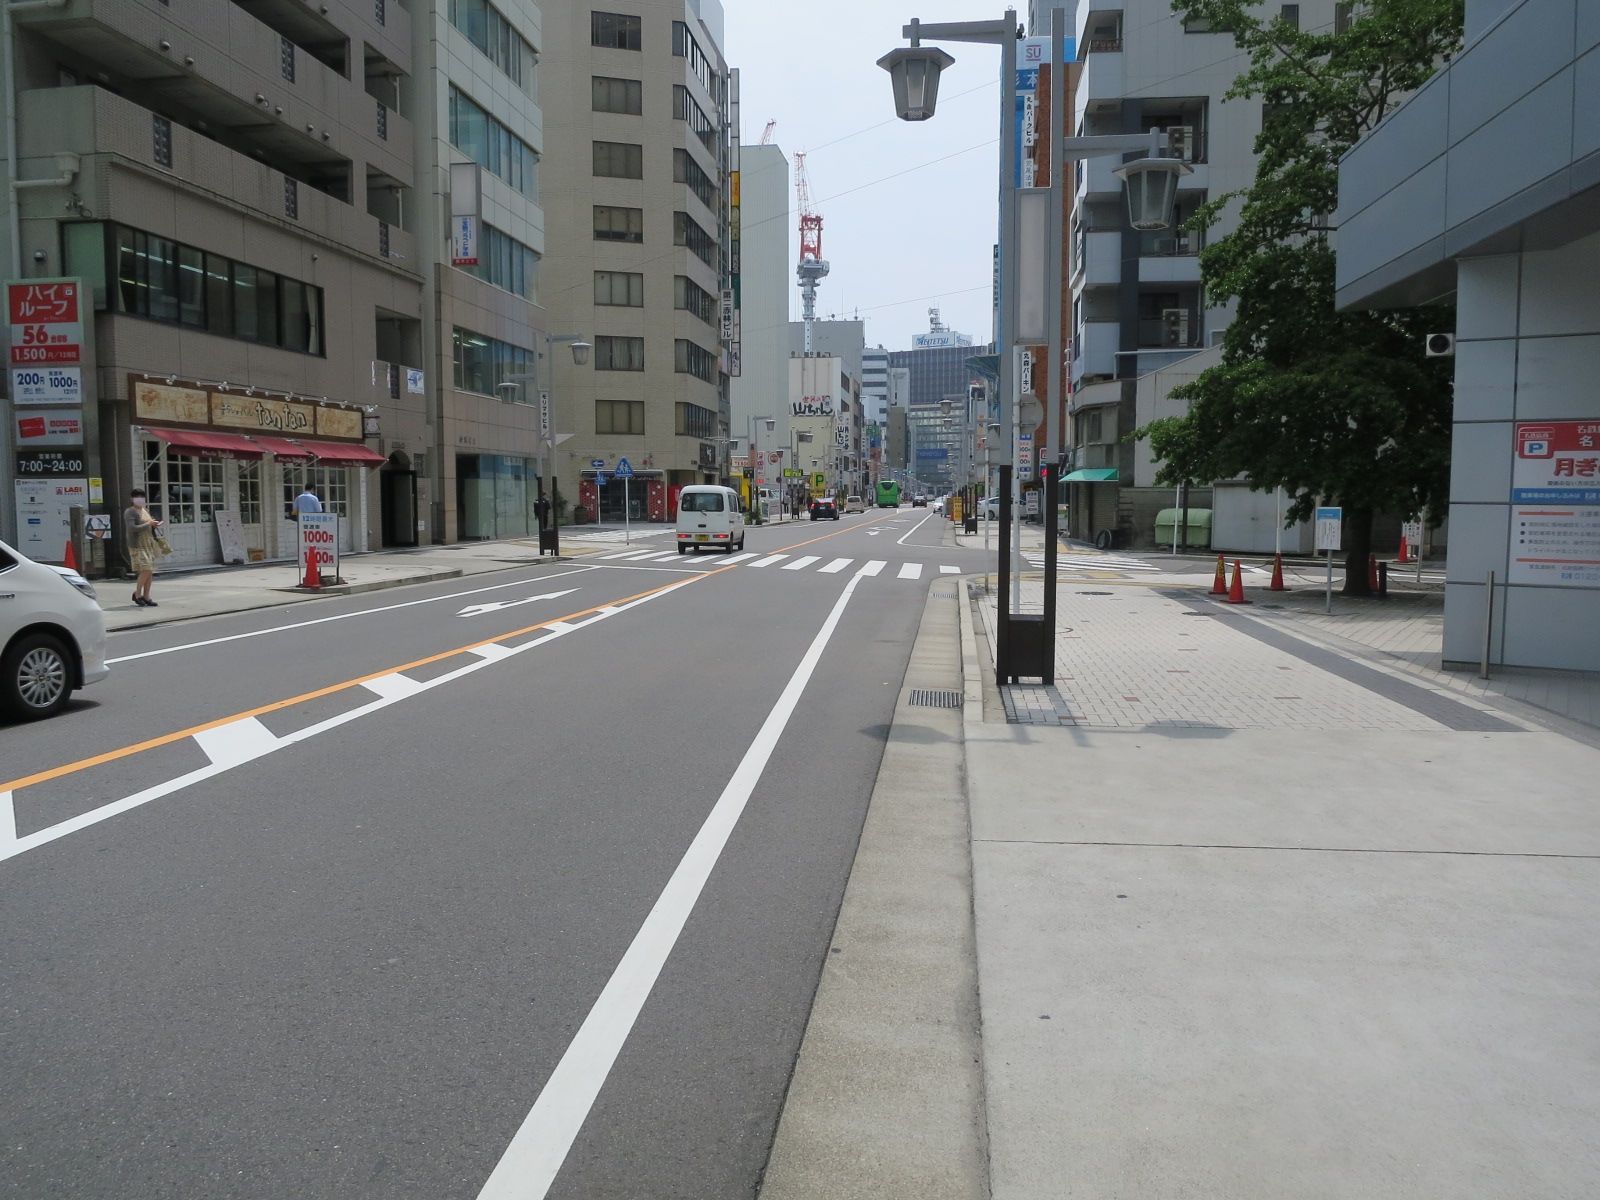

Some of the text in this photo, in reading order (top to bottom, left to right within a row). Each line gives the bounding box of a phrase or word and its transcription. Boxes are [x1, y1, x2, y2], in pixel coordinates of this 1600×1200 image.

[27, 285, 58, 300] ハイ
[20, 300, 68, 316] ルーフ
[1529, 443, 1544, 454] P
[1553, 458, 1600, 478] 月ぎ
[303, 531, 334, 543] 1000円
